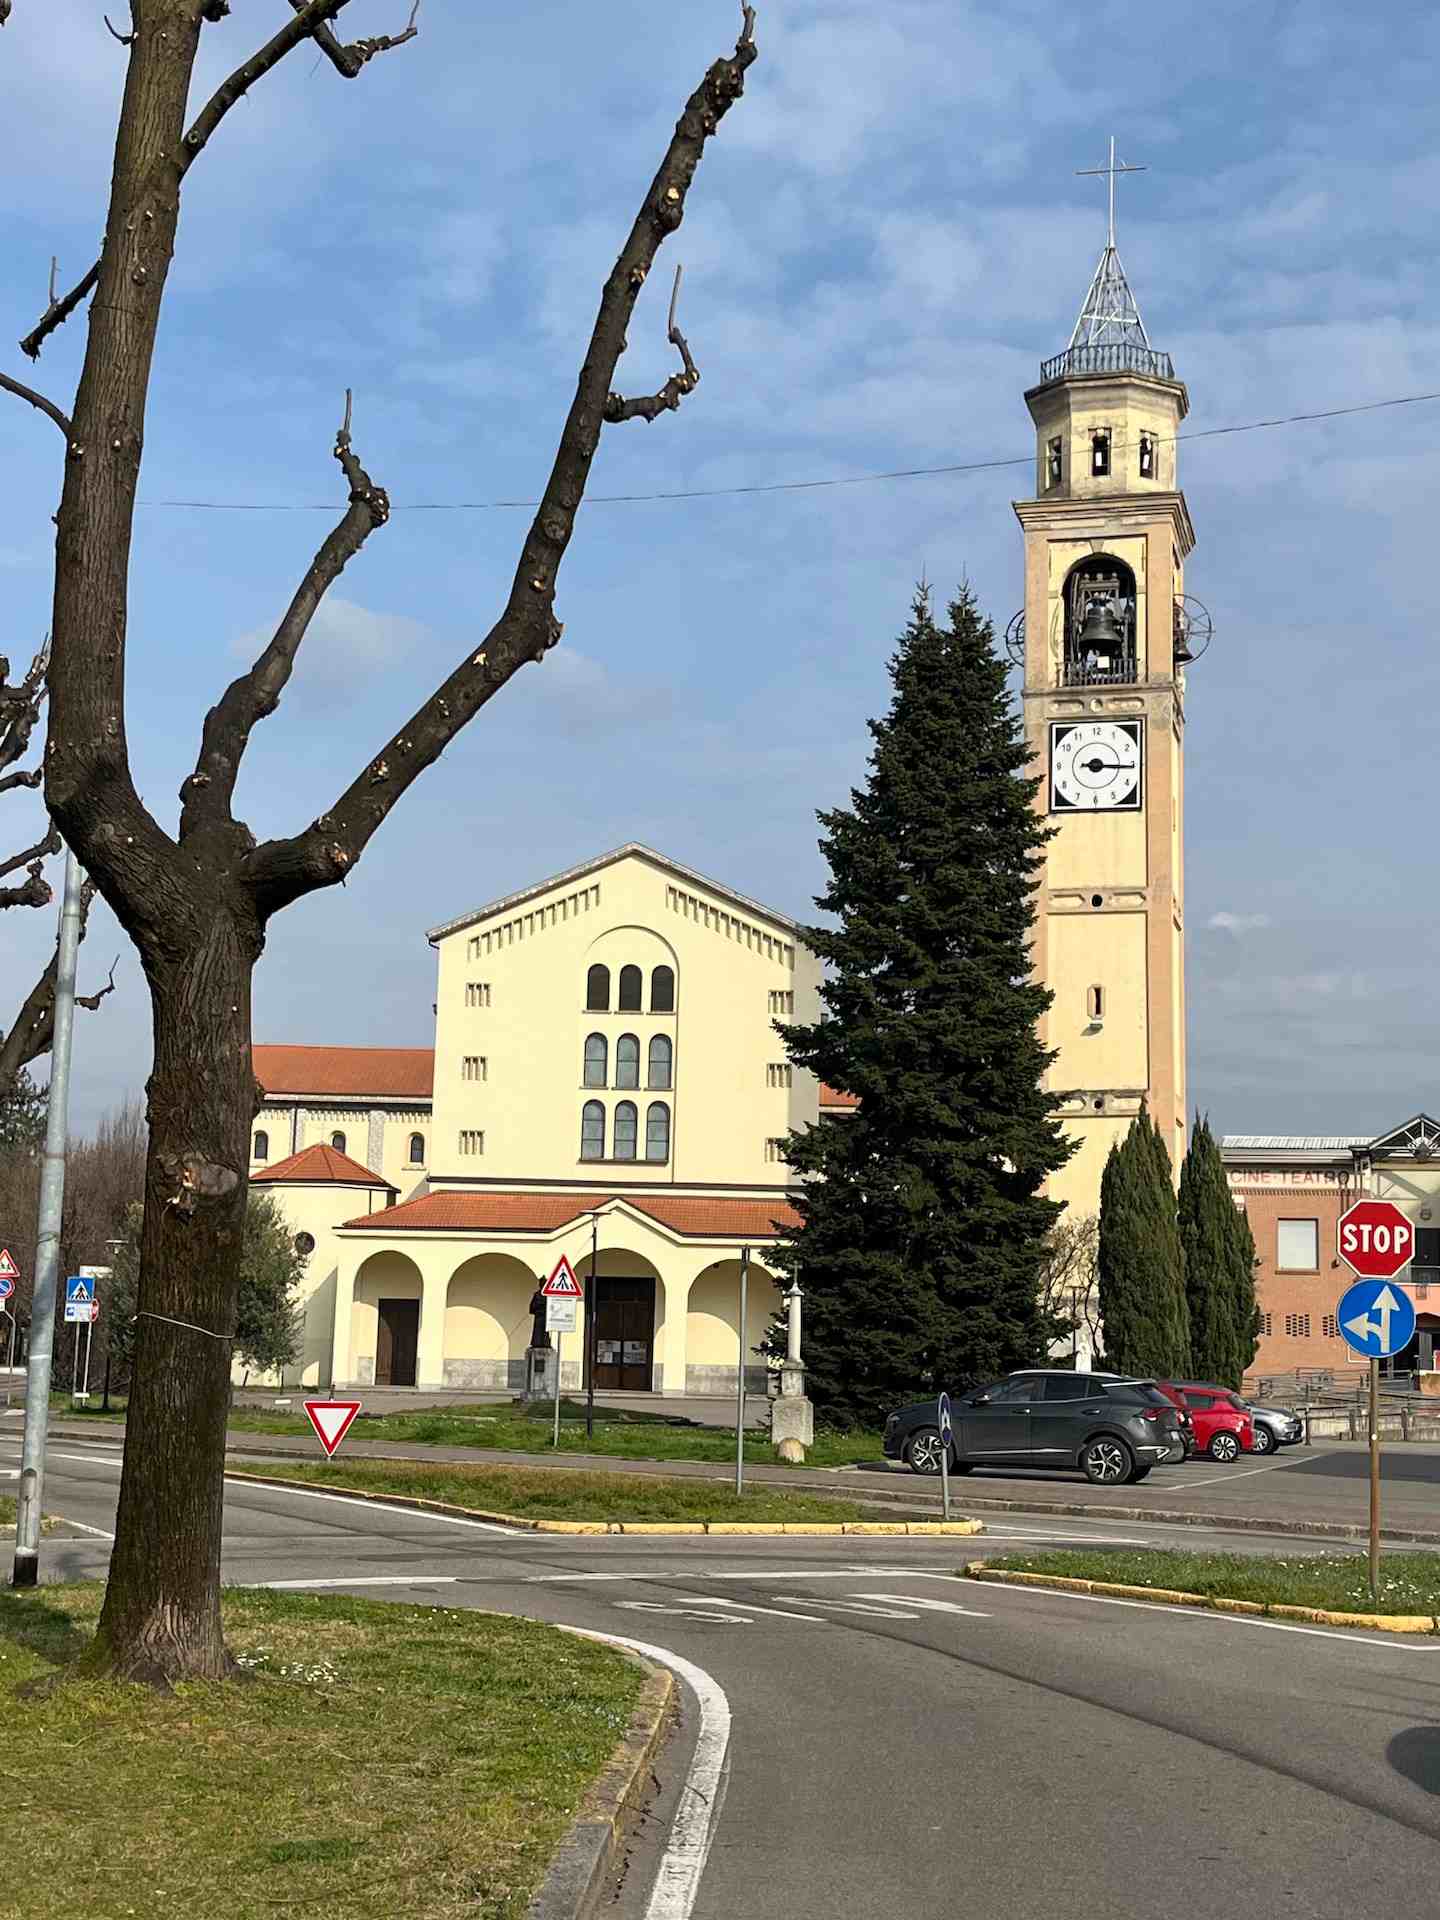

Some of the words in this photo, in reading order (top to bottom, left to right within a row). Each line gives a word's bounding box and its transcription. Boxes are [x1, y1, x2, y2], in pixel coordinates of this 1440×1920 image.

[1092, 727, 1102, 735] 12
[1074, 732, 1082, 741] 11
[1062, 743, 1071, 752] 10
[1124, 743, 1130, 752] 2
[1342, 1224, 1410, 1254] STOP
[612, 1593, 993, 1624] STOP
